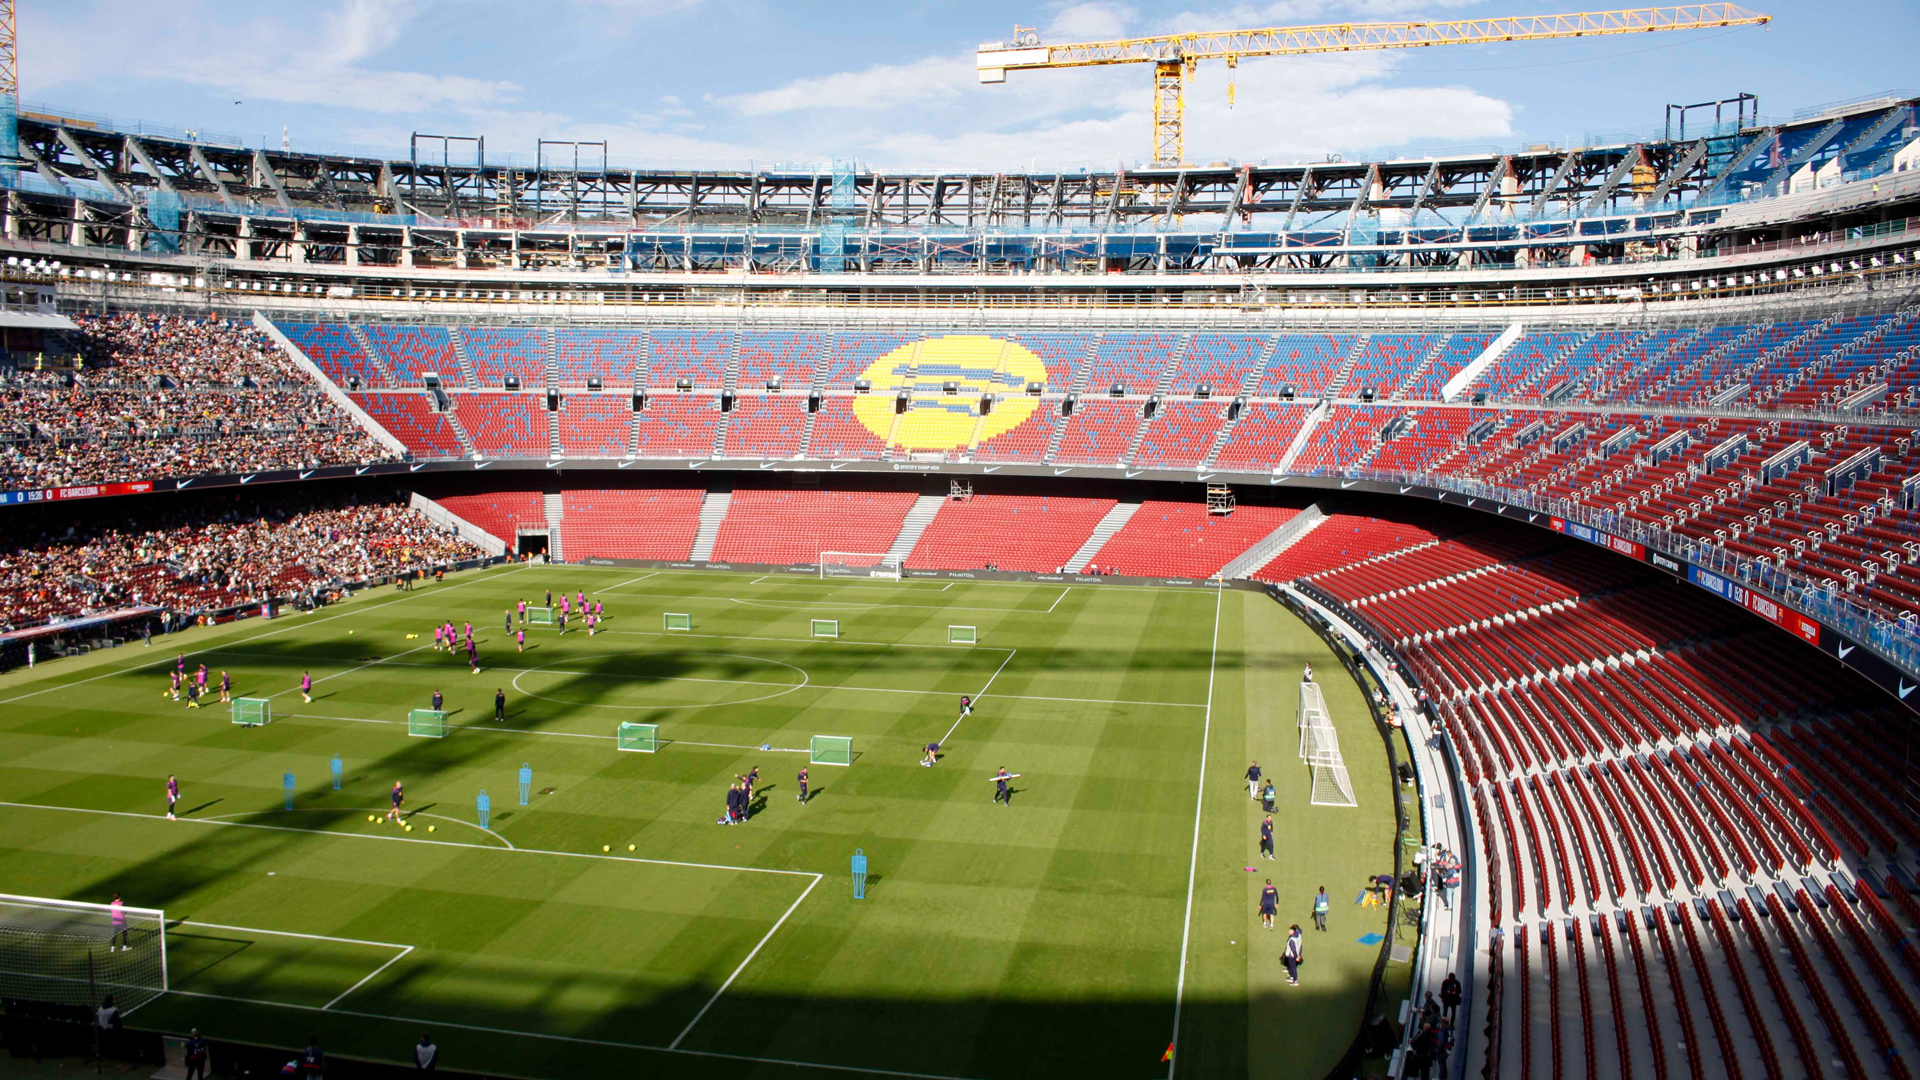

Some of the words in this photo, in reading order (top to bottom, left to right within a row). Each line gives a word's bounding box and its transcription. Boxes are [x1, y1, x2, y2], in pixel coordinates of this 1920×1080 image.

[17, 492, 23, 502] 0
[28, 491, 43, 501] 15:26
[46, 490, 52, 500] 0
[60, 488, 67, 498] FC
[68, 486, 98, 497] BARCELONA
[1706, 573, 1723, 593] BARCELONA
[1728, 583, 1732, 598] 0
[1745, 590, 1748, 606] 0
[1758, 597, 1777, 620] BARCELONA
